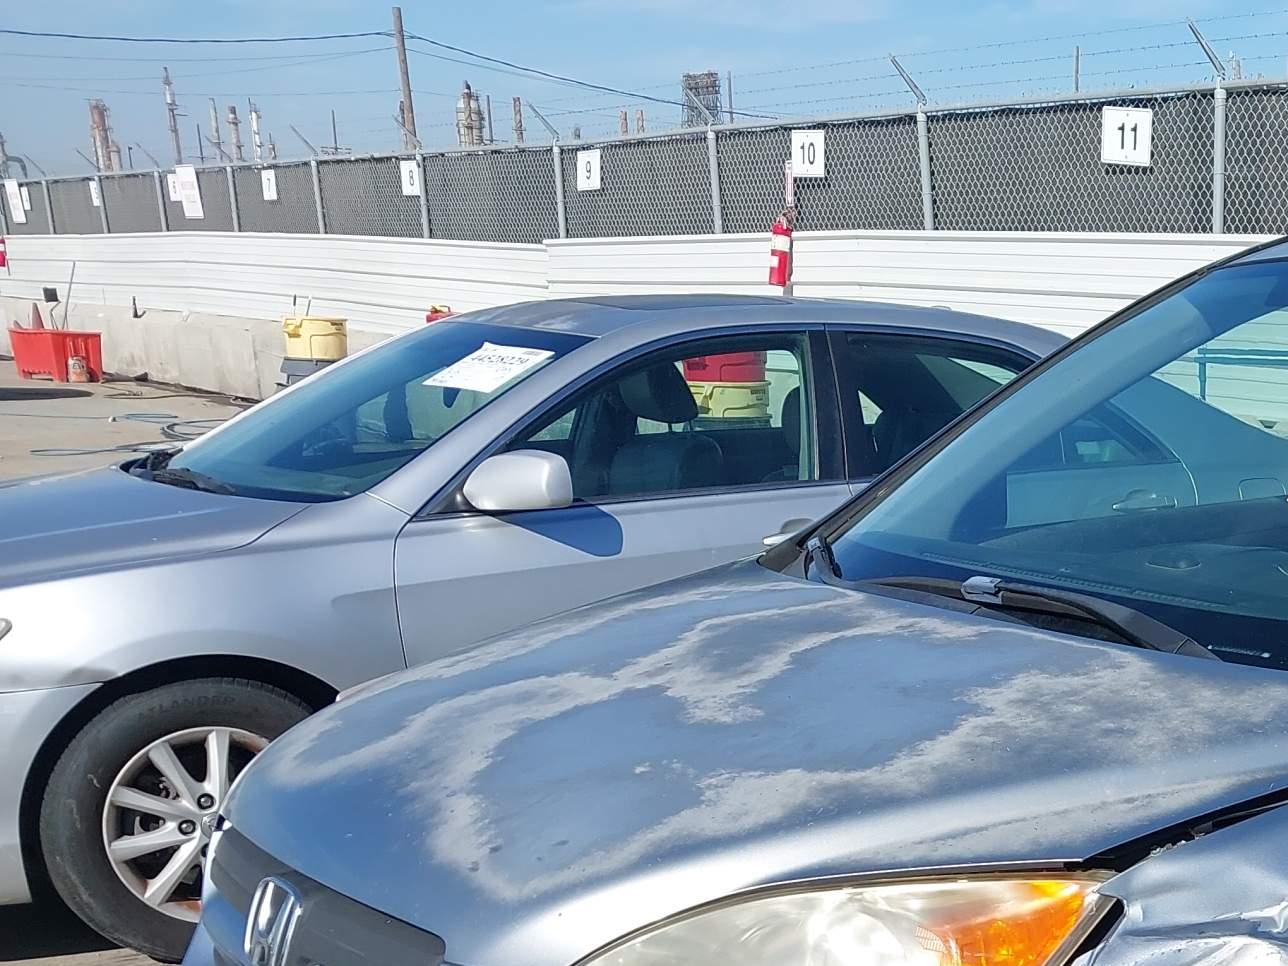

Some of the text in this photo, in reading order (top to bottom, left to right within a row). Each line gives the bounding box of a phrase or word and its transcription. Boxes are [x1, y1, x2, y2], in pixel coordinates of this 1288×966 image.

[1117, 122, 1138, 151] 11
[799, 142, 816, 165] 10
[408, 169, 415, 186] 8
[584, 160, 592, 180] 9
[266, 177, 272, 193] 7
